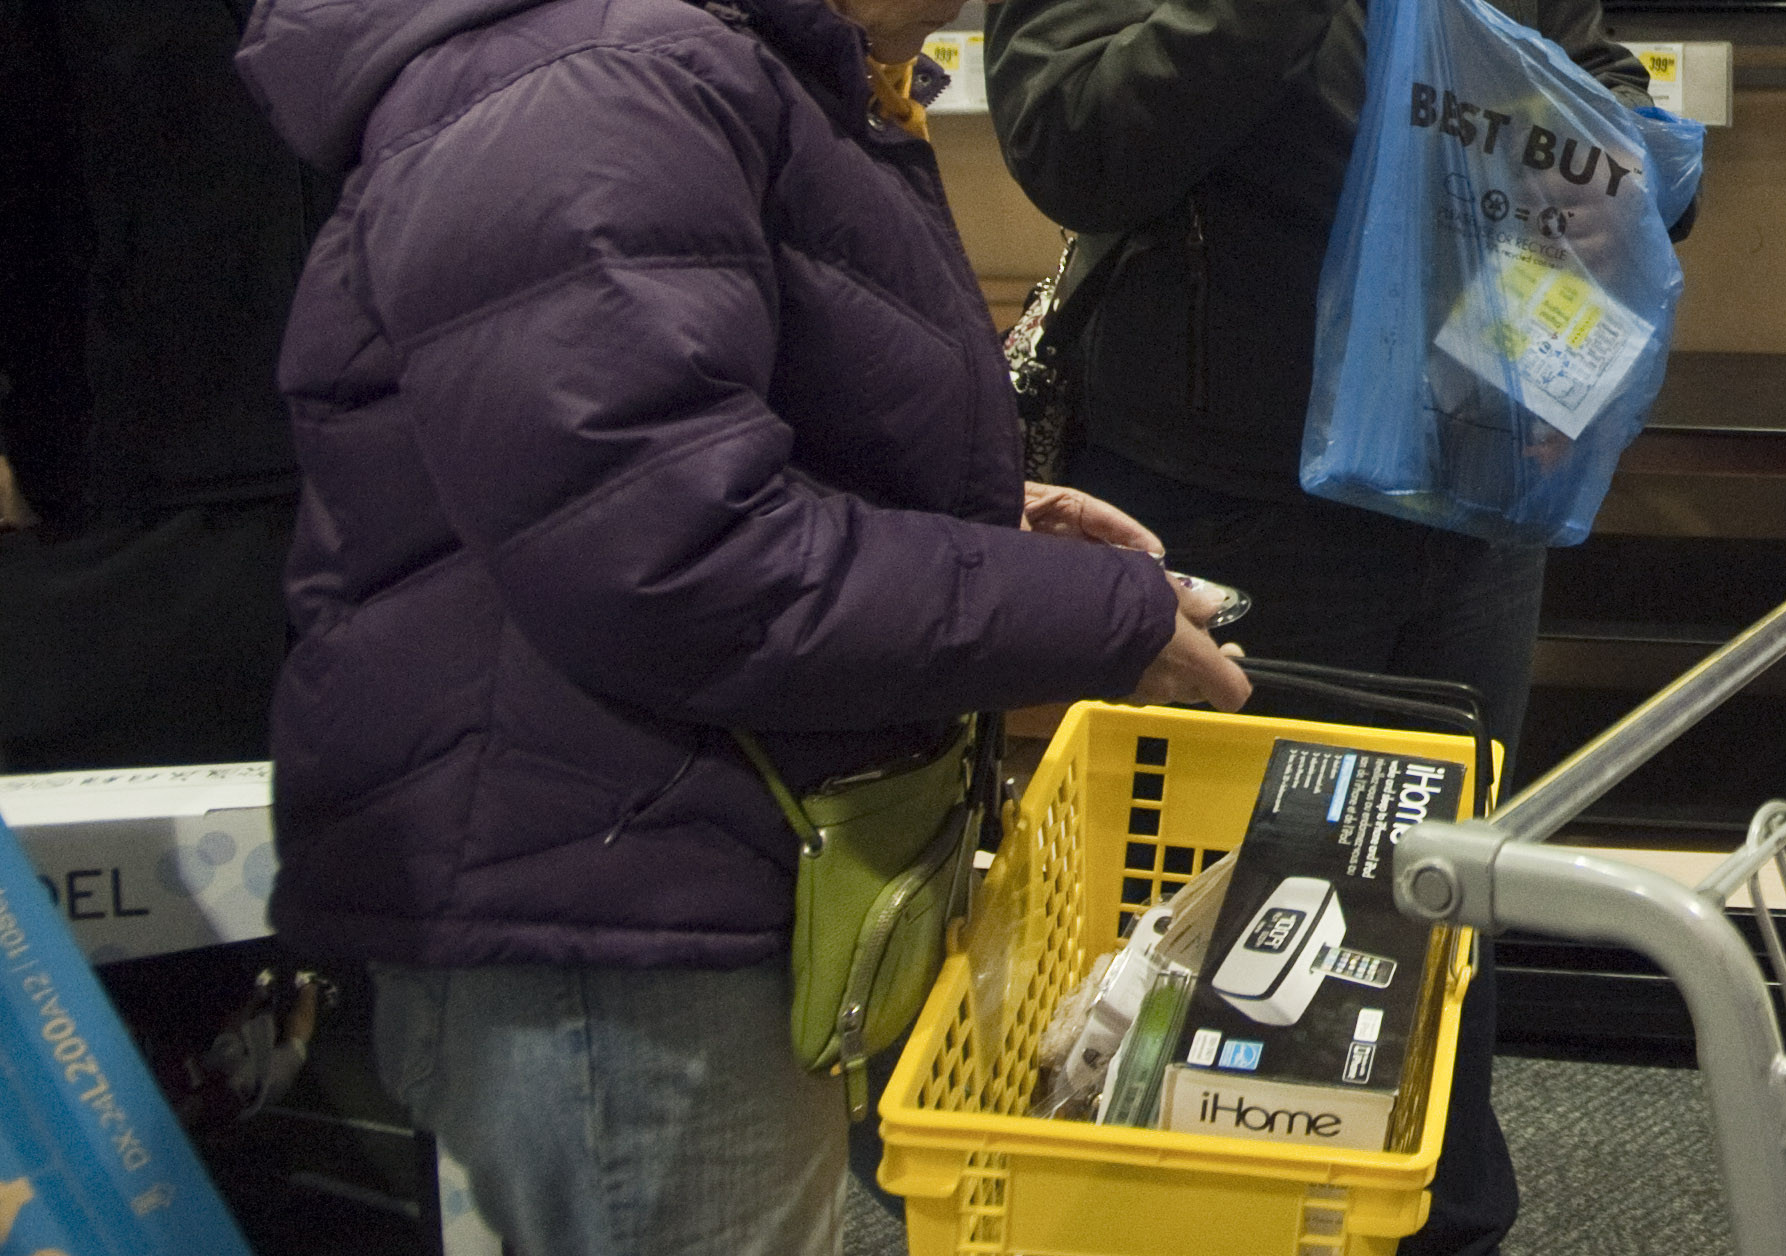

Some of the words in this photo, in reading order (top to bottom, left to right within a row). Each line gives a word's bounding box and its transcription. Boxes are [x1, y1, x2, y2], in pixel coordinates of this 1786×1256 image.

[1410, 82, 1511, 155] BEST
[1521, 124, 1631, 198] BUY
[1383, 778, 1397, 794] and
[1370, 821, 1388, 845] iPhone
[1366, 845, 1380, 862] and
[1362, 861, 1378, 879] iPod
[1199, 1091, 1342, 1138] iHome
